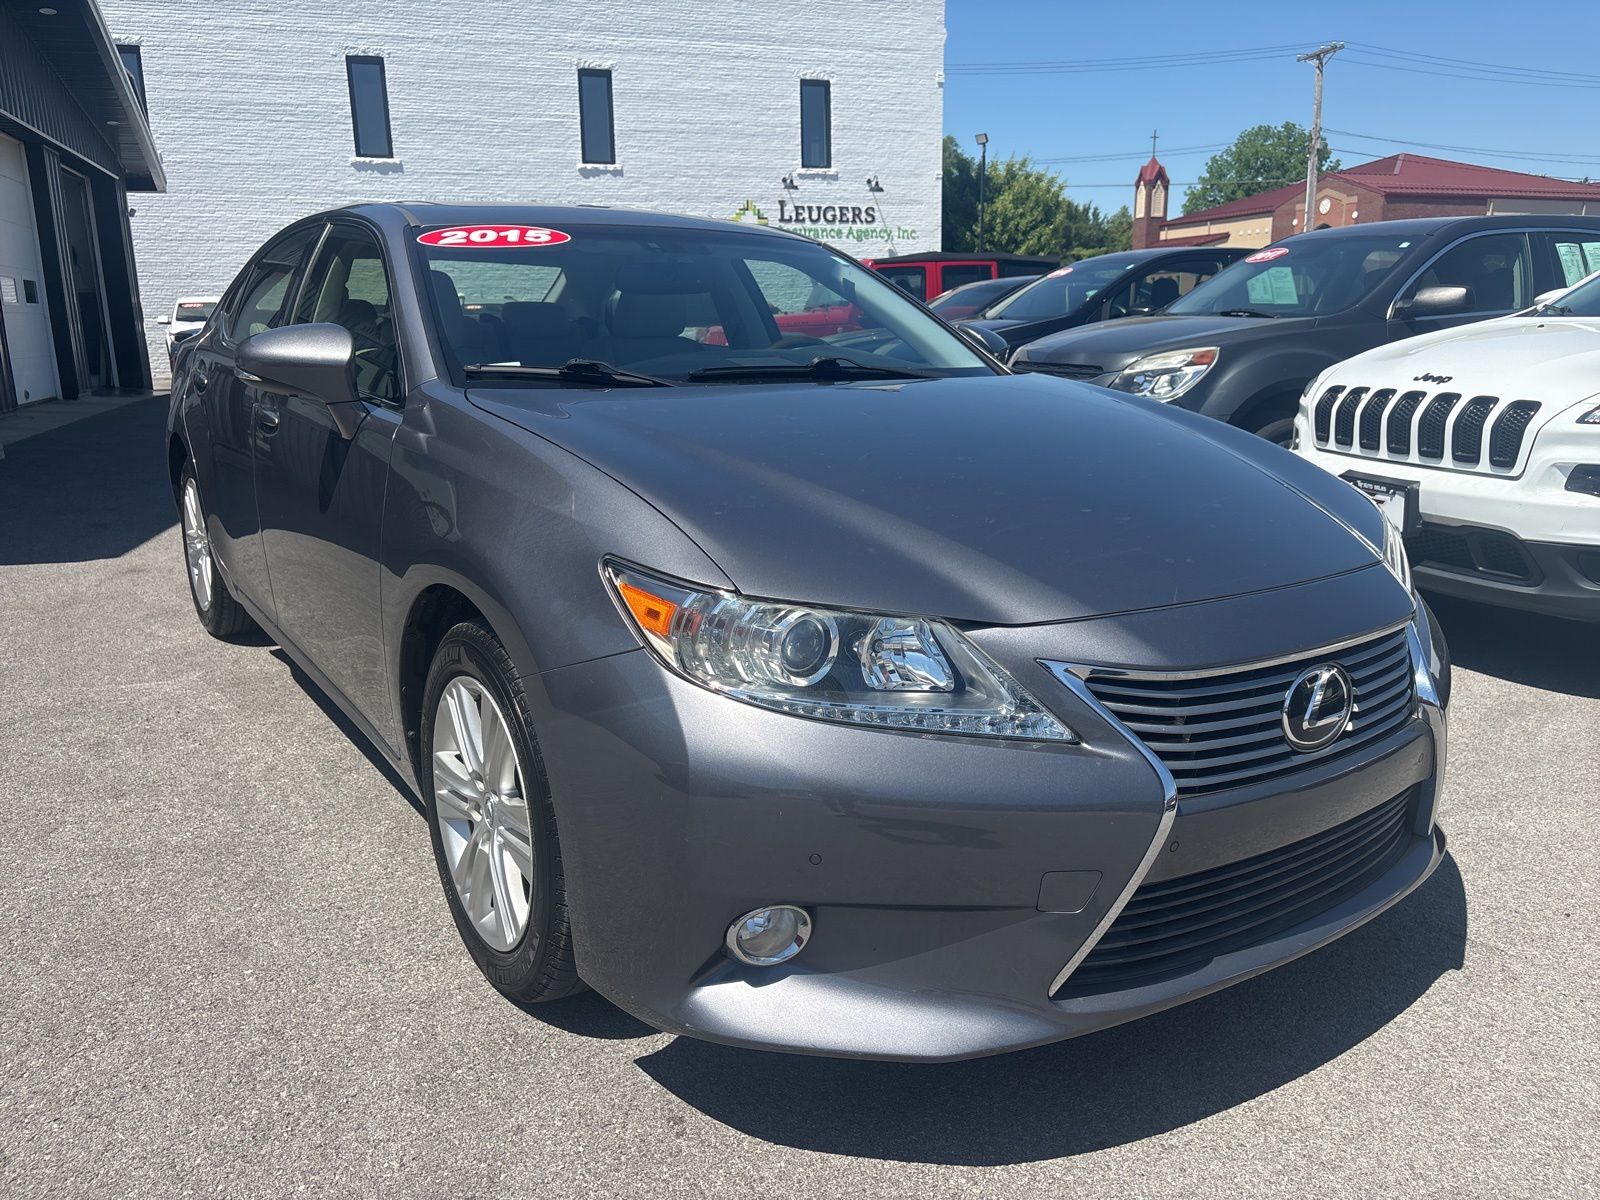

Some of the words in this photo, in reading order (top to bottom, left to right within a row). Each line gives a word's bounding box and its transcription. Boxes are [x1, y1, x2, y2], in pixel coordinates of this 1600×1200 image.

[778, 199, 876, 224] LEUGERS
[437, 229, 553, 245] 2015
[778, 224, 844, 240] urance
[846, 226, 894, 242] Agency,
[897, 226, 920, 240] Inc.
[1413, 372, 1453, 385] Jeep
